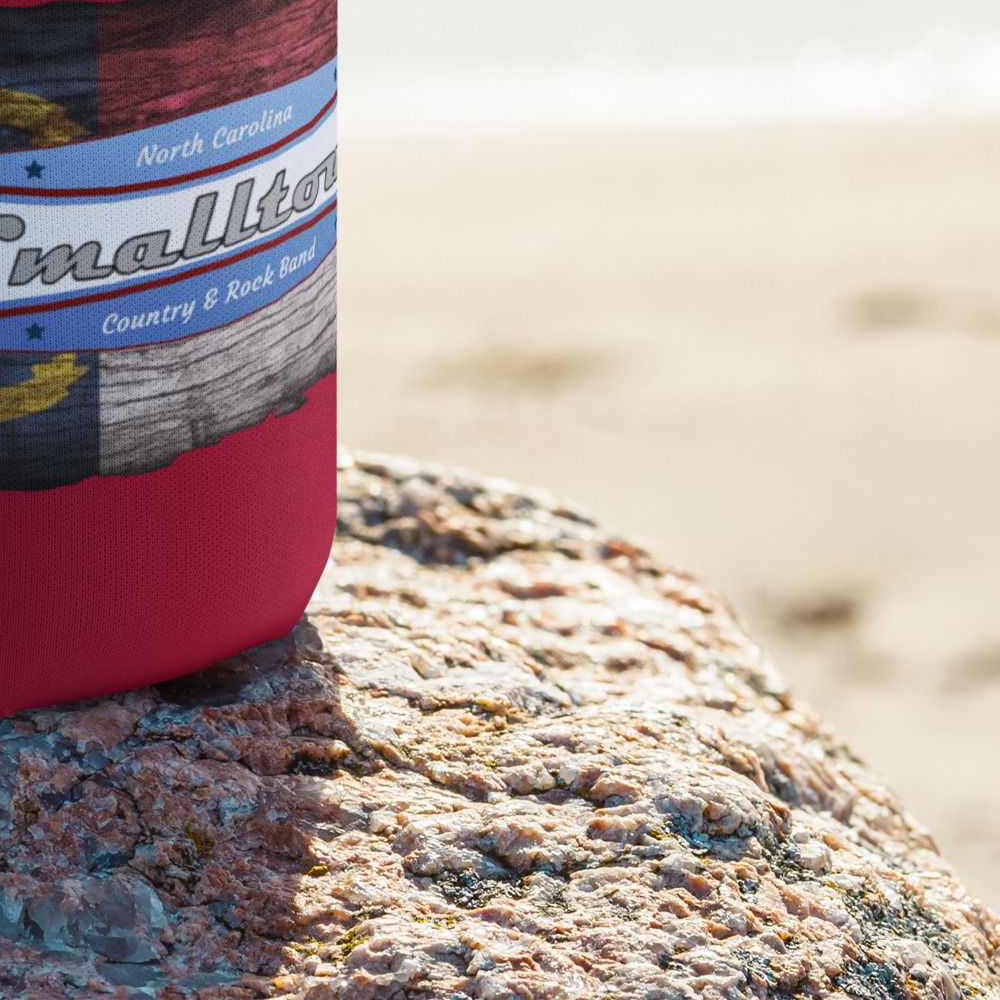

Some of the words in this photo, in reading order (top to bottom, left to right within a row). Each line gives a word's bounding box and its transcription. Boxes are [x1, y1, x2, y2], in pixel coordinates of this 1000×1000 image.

[135, 131, 205, 168] North
[212, 104, 293, 149] Carolina
[102, 300, 196, 335] Country
[203, 287, 219, 311] &
[224, 264, 275, 304] Rock
[279, 235, 317, 280] Band
